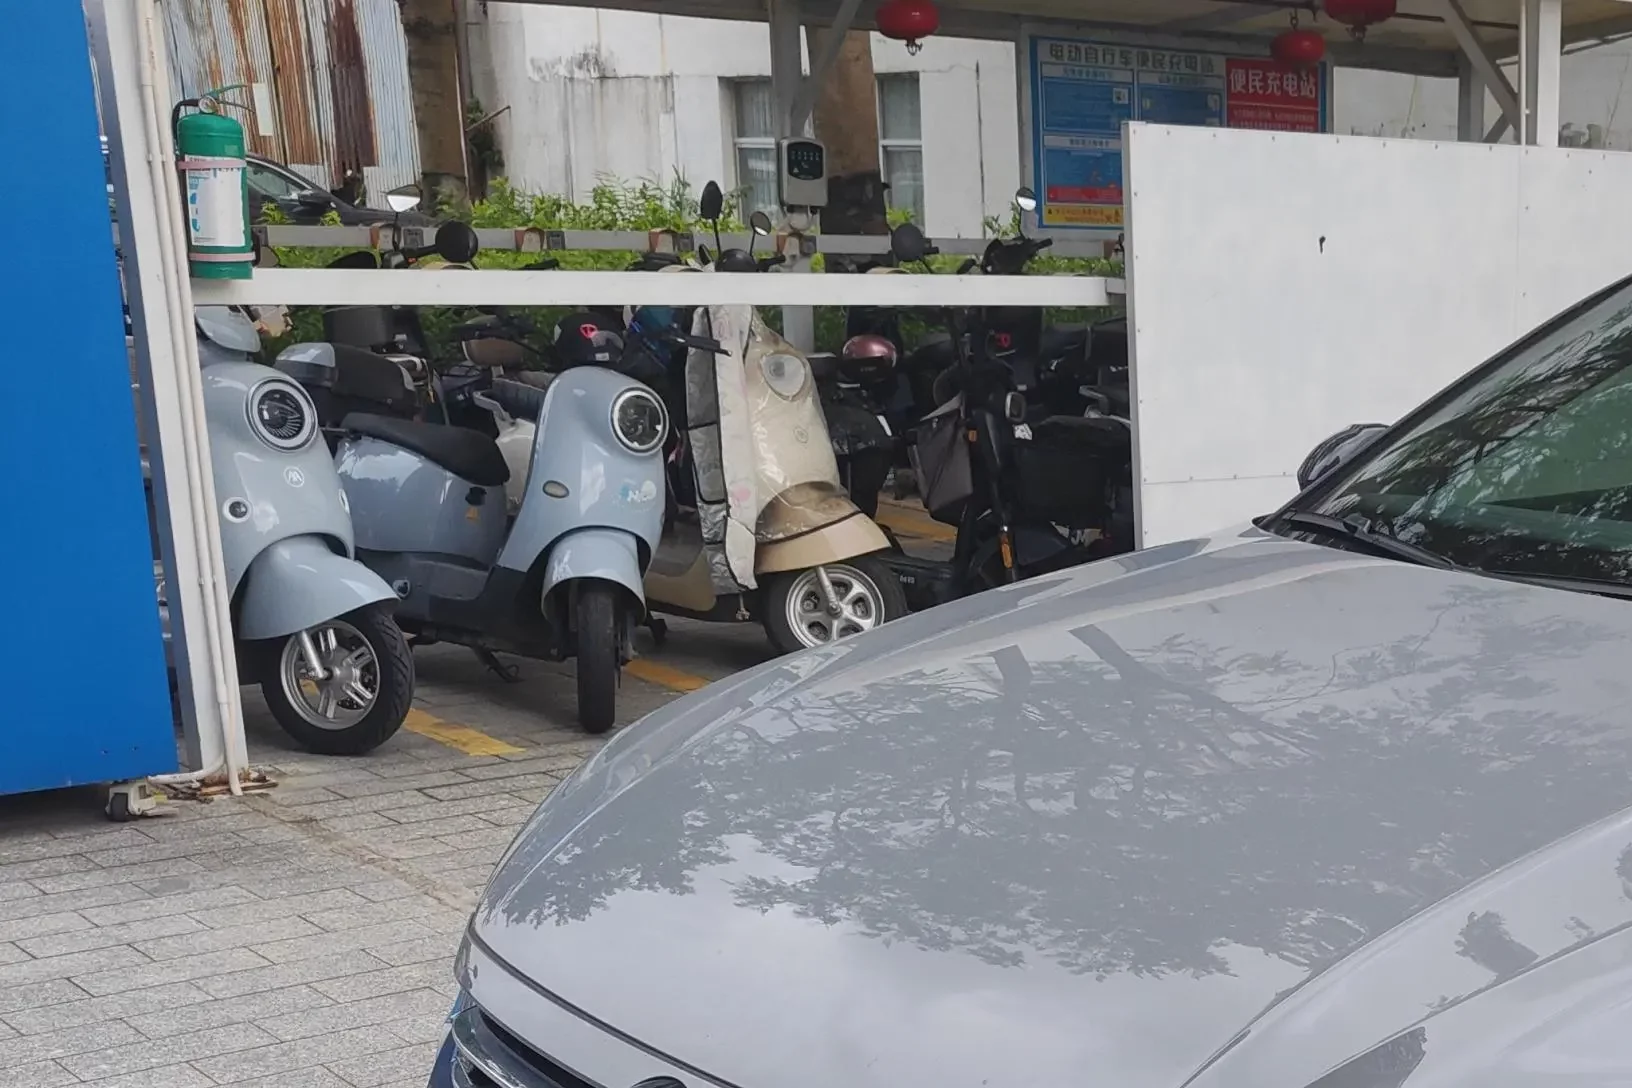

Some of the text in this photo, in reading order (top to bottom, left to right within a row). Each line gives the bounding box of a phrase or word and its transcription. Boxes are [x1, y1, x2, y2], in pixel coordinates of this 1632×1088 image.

[1049, 43, 1215, 74] 电动自行车便民充电站
[1229, 68, 1316, 98] 便民充电站
